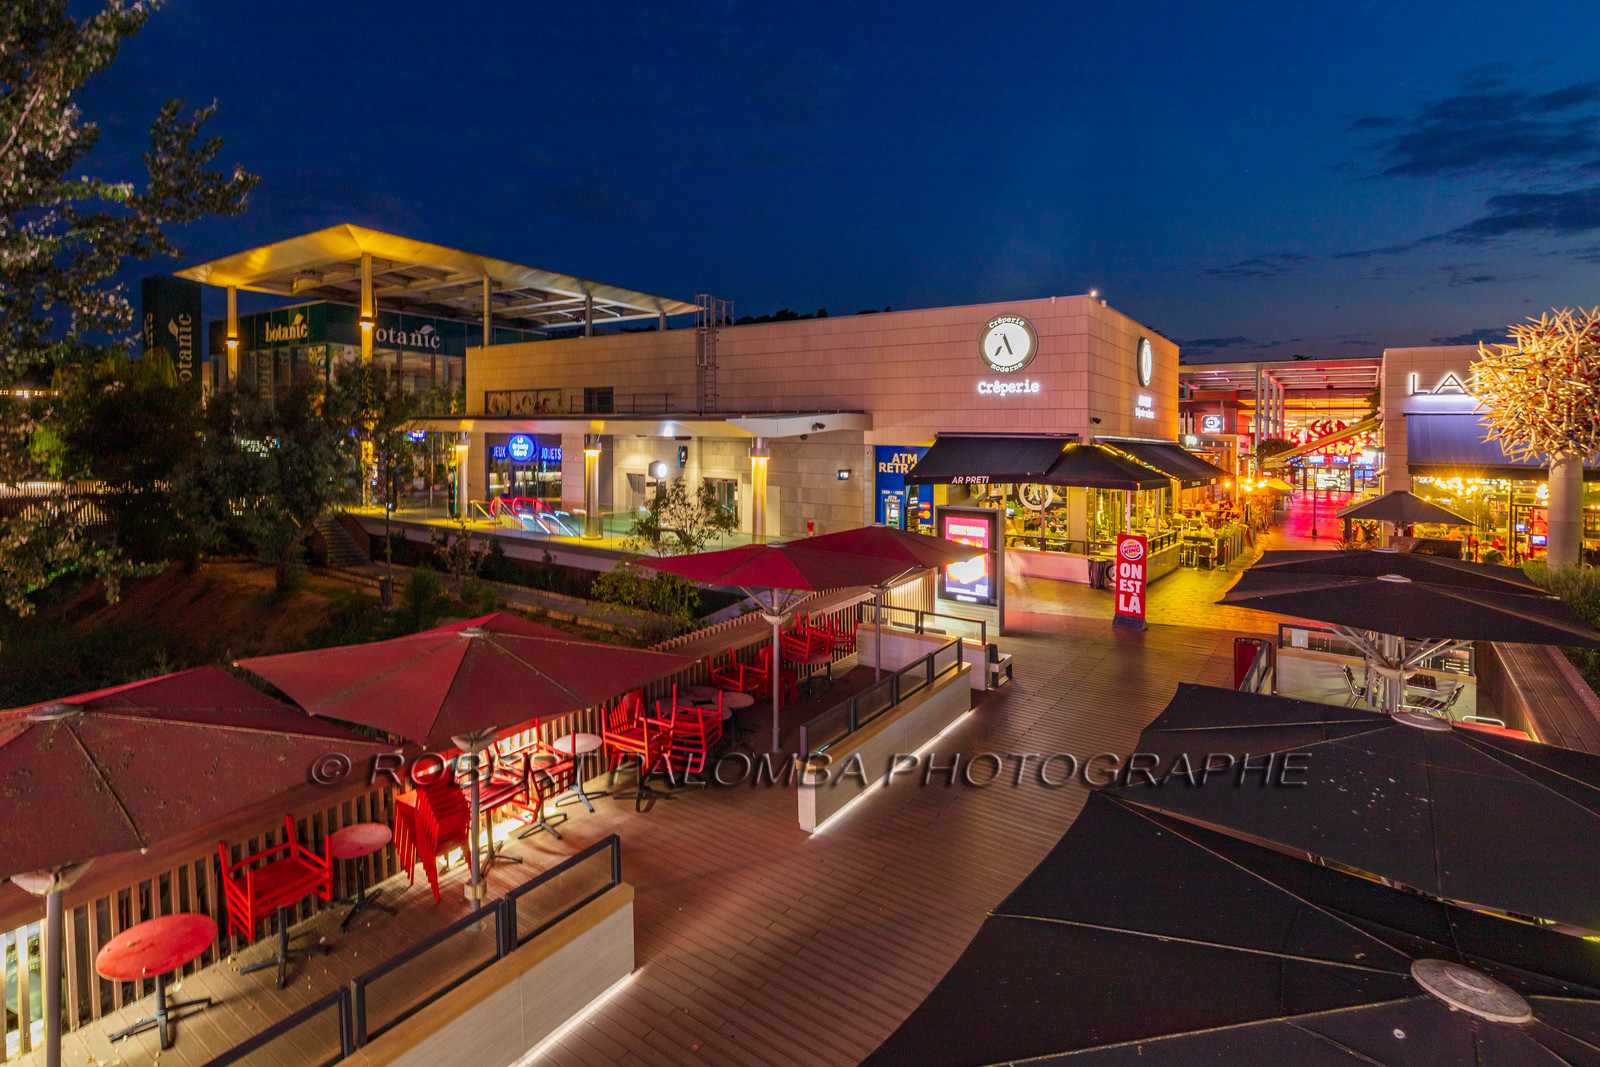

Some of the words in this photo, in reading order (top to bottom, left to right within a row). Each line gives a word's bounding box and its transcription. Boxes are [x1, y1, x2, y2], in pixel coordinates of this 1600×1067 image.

[265, 315, 307, 342] botanic
[375, 325, 441, 349] otanic
[172, 313, 192, 382] otanic
[990, 362, 1024, 373] moderne
[978, 379, 1040, 397] Crêperie
[1411, 373, 1470, 395] LA
[493, 446, 506, 458] JEUX
[891, 453, 918, 465] ATM
[951, 476, 964, 485] AR
[965, 475, 990, 485] PRETI
[1123, 548, 1142, 556] KING
[1119, 562, 1143, 580] ON
[1119, 578, 1142, 594] EST
[1118, 593, 1142, 614] LÀ
